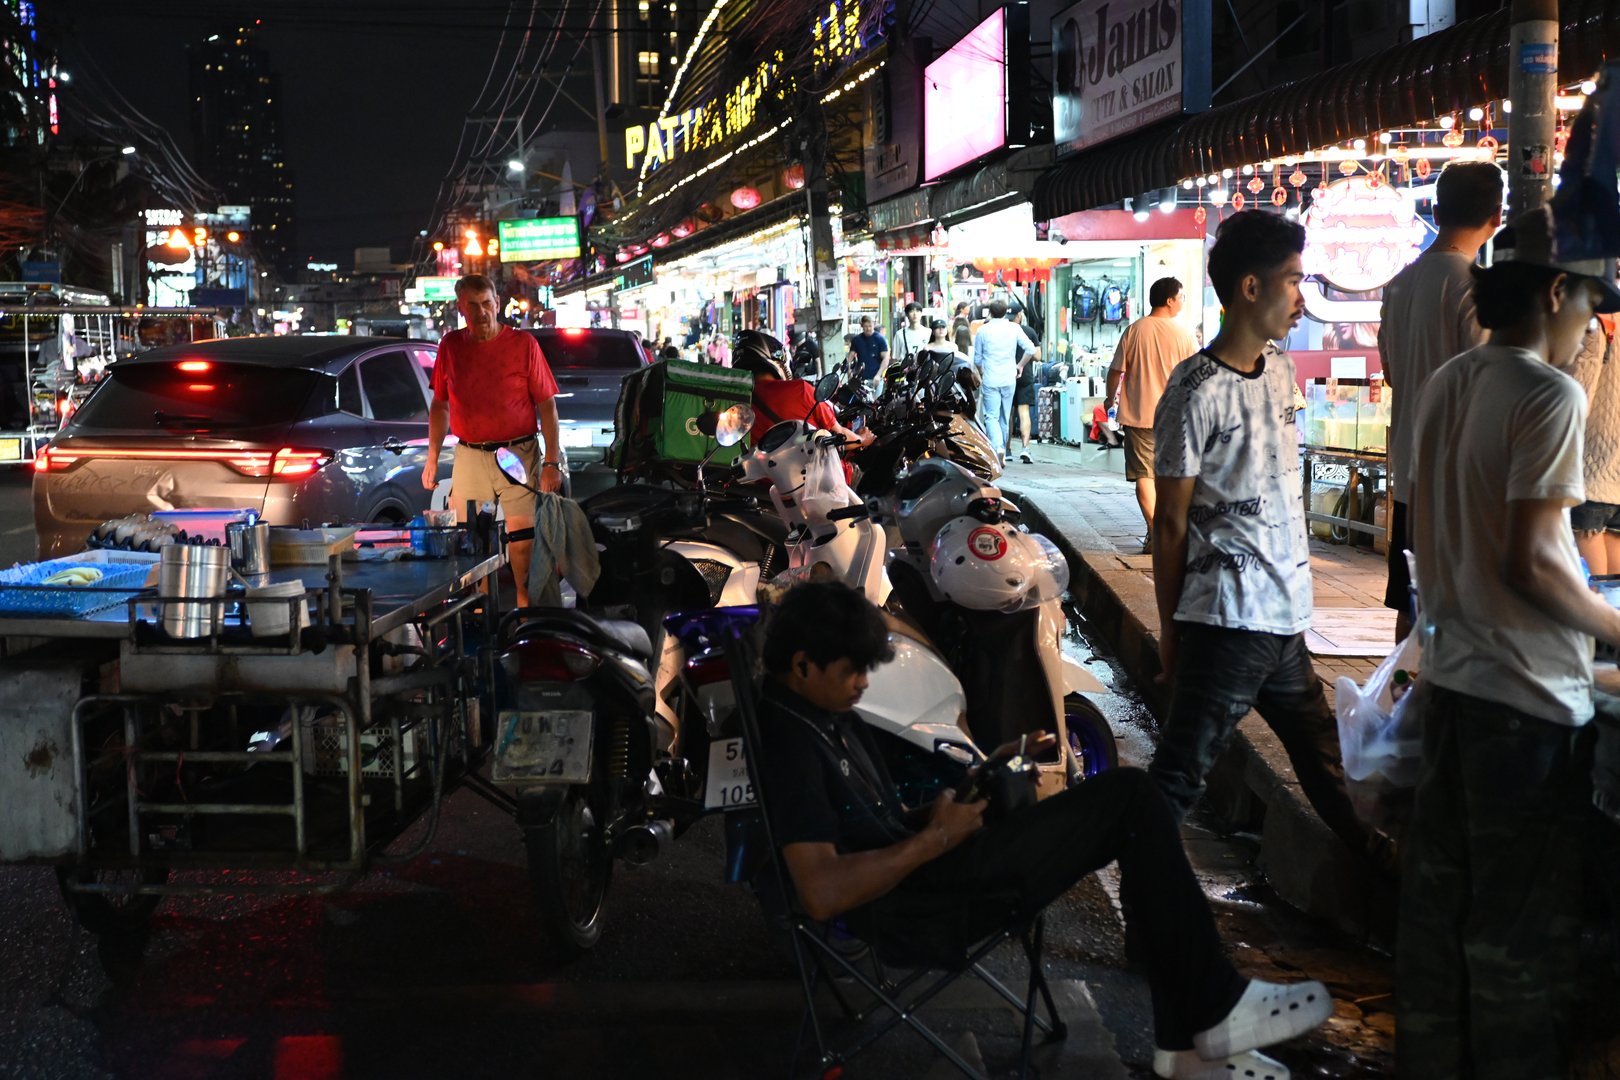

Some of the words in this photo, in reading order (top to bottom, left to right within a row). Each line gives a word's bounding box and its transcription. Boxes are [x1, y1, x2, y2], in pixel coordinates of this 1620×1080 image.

[1119, 85, 1128, 111] &
[1132, 61, 1176, 106] SALON
[726, 742, 745, 762] 5
